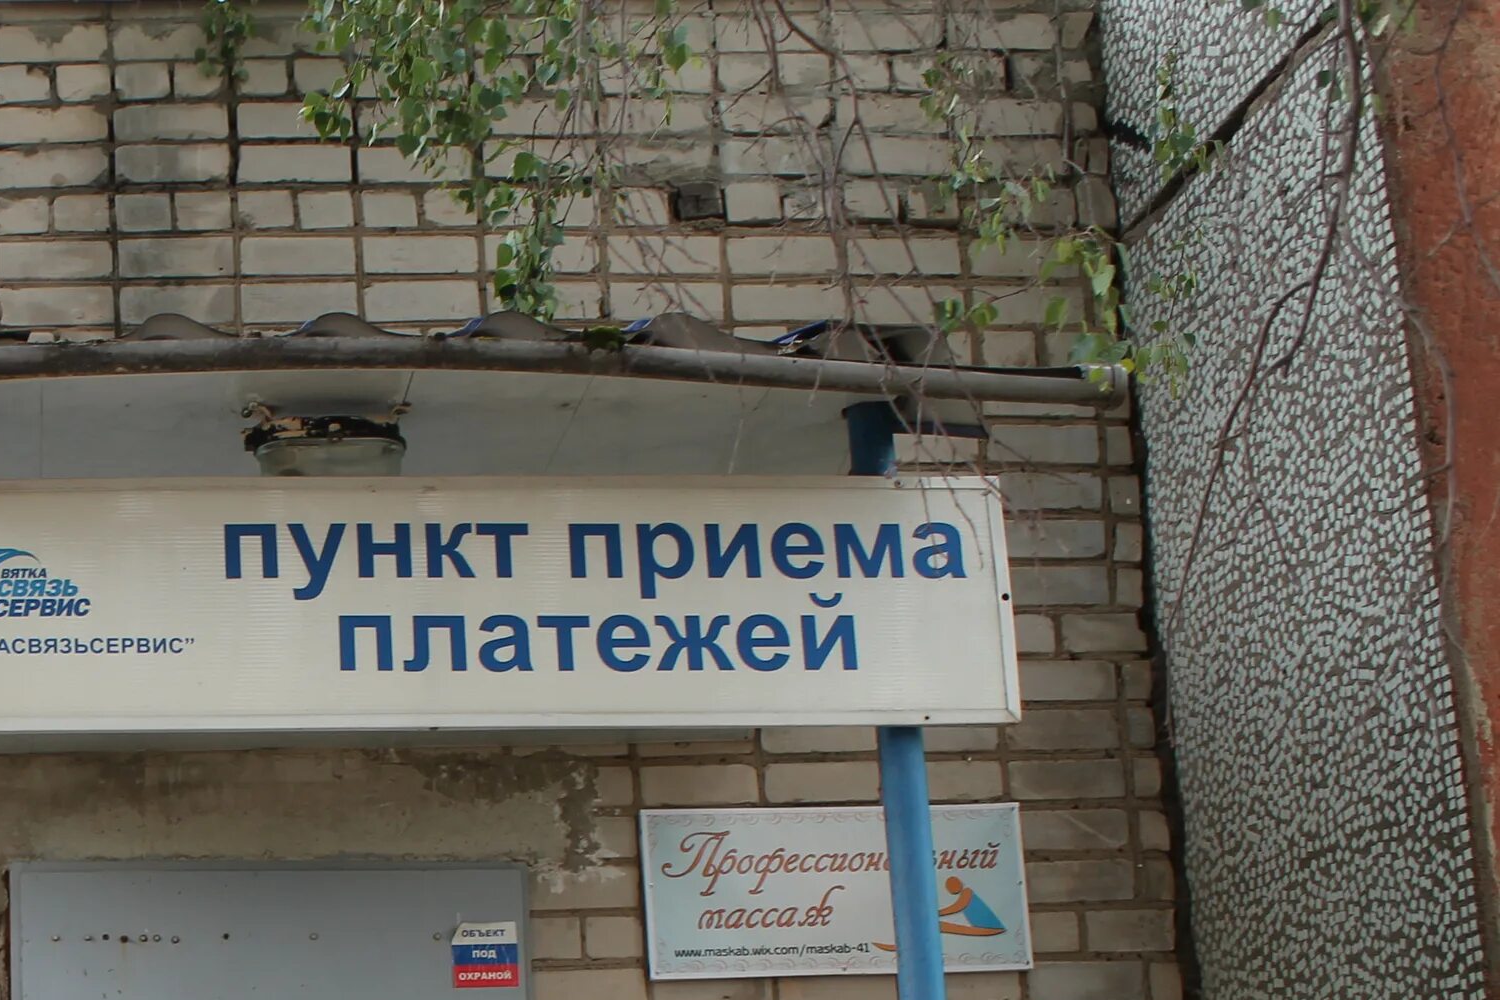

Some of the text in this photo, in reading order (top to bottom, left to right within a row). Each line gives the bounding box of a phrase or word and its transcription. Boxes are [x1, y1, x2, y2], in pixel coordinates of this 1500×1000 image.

[223, 521, 967, 600] пункт приема
[0, 568, 48, 579] ВЯТКА
[339, 592, 860, 673] платежей
[698, 885, 846, 930] массаж
[461, 929, 506, 938] ОБЪЕКТ
[471, 949, 498, 959] ПОД
[458, 969, 512, 981] ОХРАНОЙ
